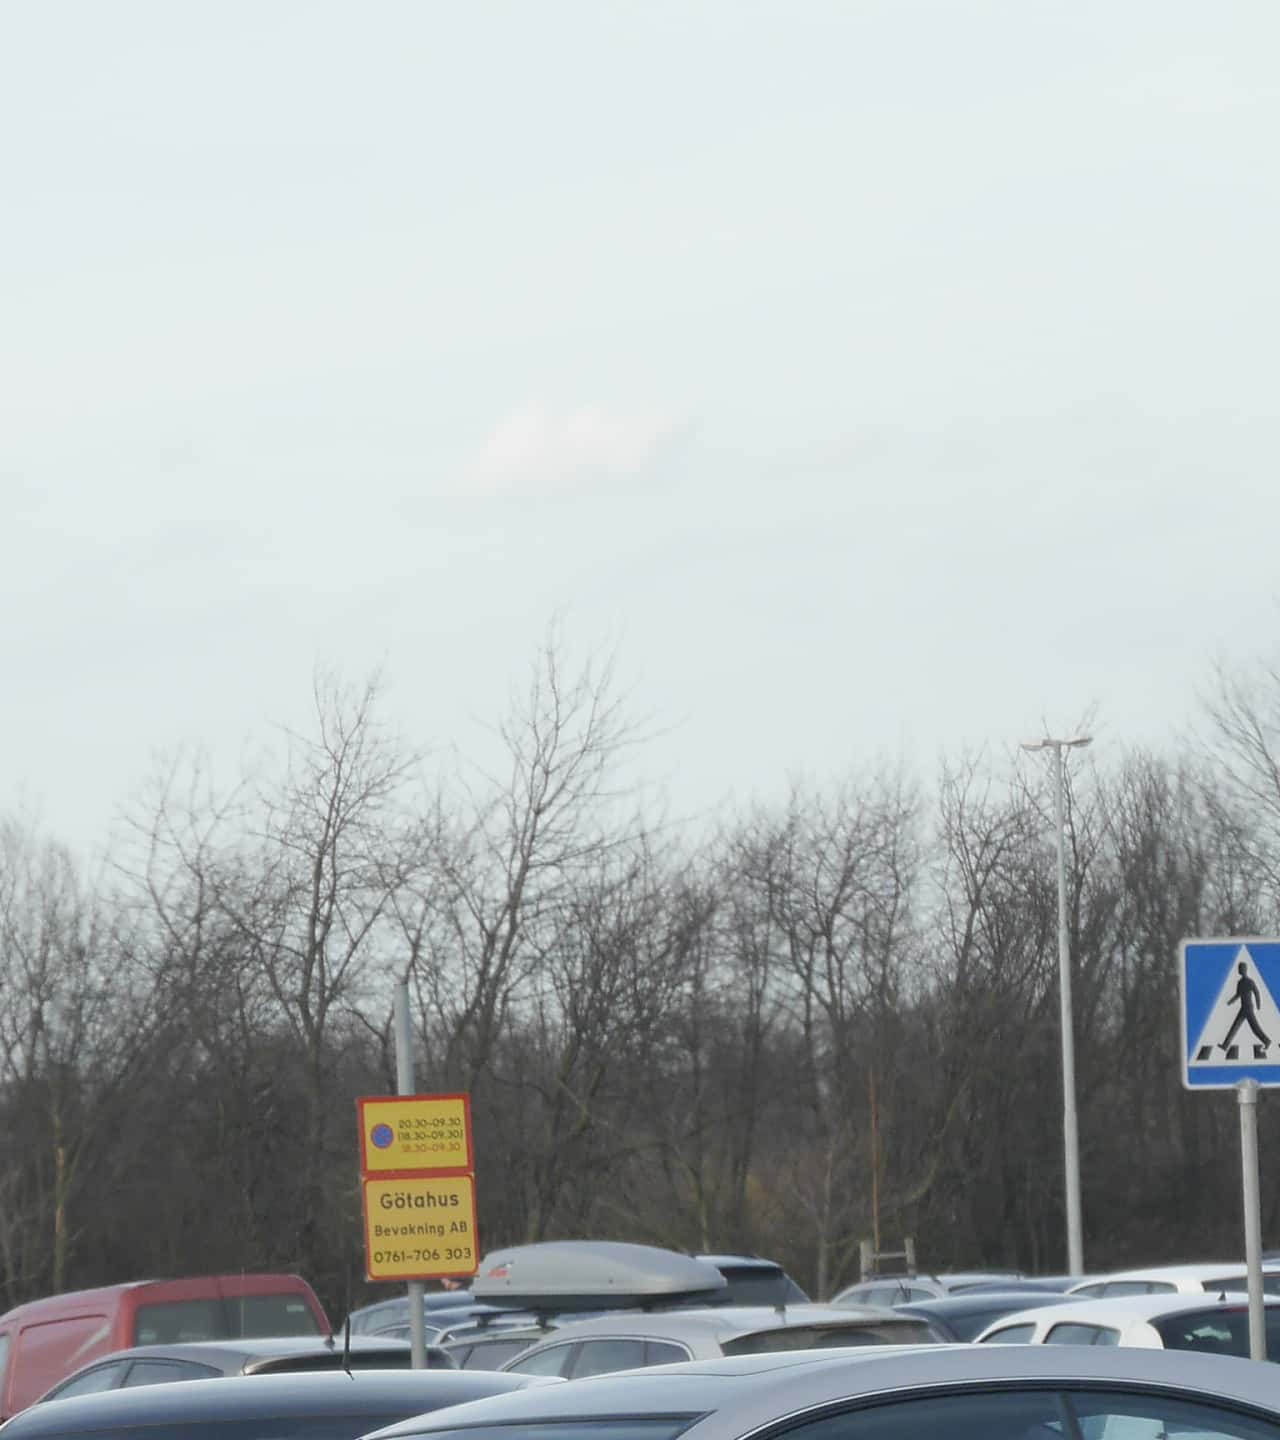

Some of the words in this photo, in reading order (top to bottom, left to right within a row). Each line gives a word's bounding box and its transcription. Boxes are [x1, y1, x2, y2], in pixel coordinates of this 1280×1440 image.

[380, 1191, 460, 1210] Götahus
[375, 1223, 445, 1238] Bevakning
[450, 1221, 468, 1233] AB
[374, 1250, 441, 1264] 0761-706
[446, 1248, 472, 1260] 303
